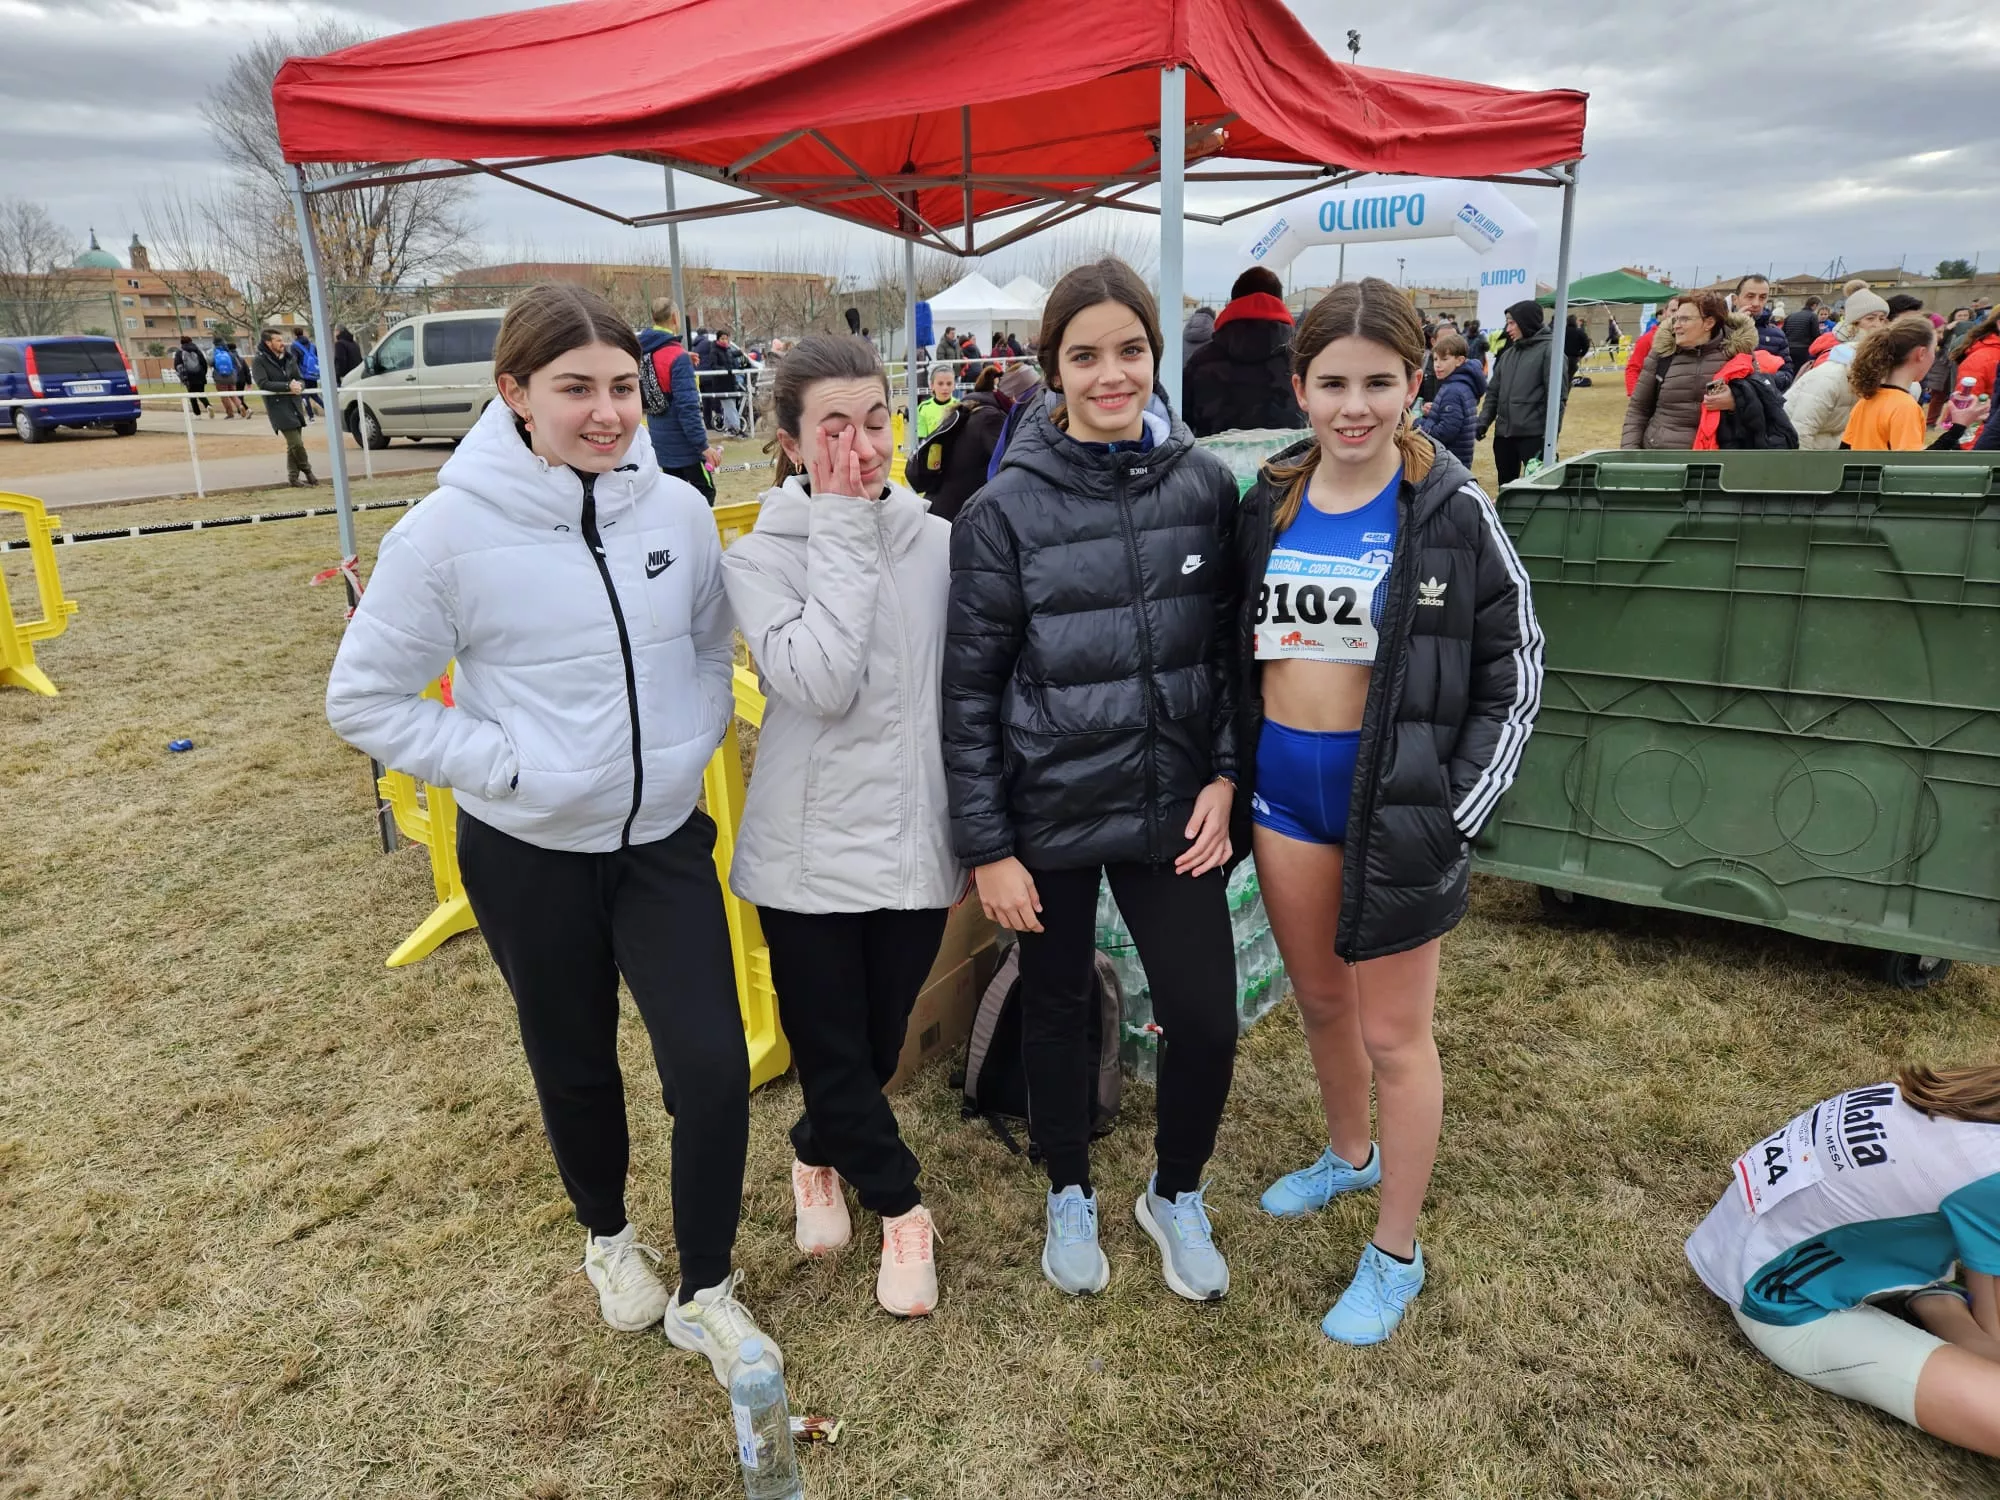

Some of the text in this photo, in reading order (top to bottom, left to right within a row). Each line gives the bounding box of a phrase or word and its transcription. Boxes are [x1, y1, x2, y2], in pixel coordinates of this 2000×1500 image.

[1318, 193, 1425, 233] OLIMPO
[1474, 213, 1504, 239] OLIMPO
[1262, 218, 1287, 245] OLIMPO
[1481, 269, 1525, 286] OLIMPO
[648, 549, 671, 567] NIKE
[1308, 563, 1331, 575] COPA
[1332, 564, 1376, 579] ESCOLAR
[1416, 597, 1445, 607] adidas
[1844, 1087, 1895, 1167] Mafia
[1825, 1136, 1845, 1172] MESA
